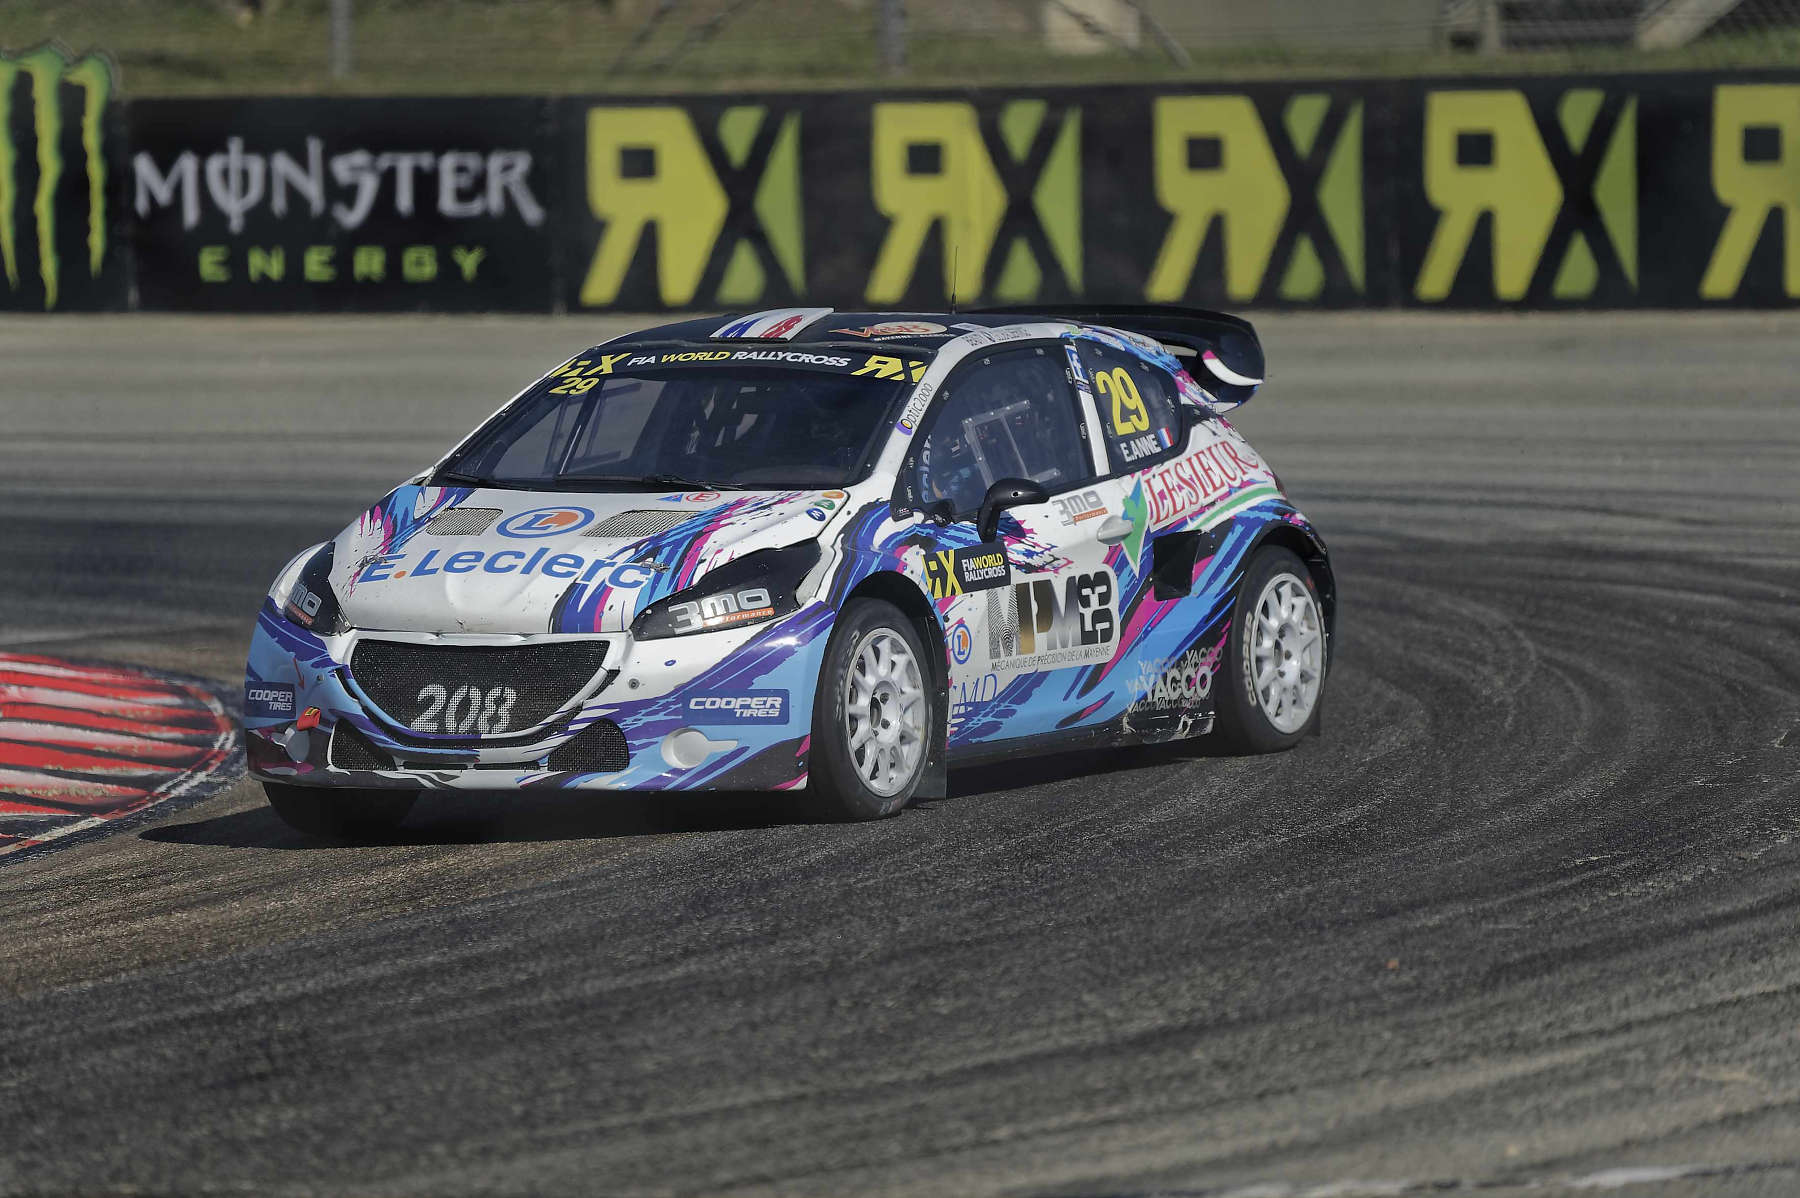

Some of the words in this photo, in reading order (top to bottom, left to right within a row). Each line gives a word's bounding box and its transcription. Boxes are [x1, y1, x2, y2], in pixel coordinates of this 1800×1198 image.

[134, 136, 545, 231] MONSTER
[200, 244, 486, 283] ENERGY
[627, 355, 656, 366] FIA
[661, 351, 731, 364] WORLD
[731, 350, 851, 367] RALLYCROSS
[549, 377, 599, 395] 29
[1096, 367, 1150, 436] 29
[900, 382, 933, 430] Optic2000
[1120, 434, 1162, 462] E.ANNE
[1143, 440, 1259, 526] LESIEUR
[357, 547, 652, 589] E.Leclerc
[964, 565, 1006, 582] RALLYCROSS
[248, 689, 293, 702] COOPER
[1141, 666, 1212, 702] YACCO
[268, 701, 292, 711] TIRES
[410, 683, 517, 735] 208
[689, 697, 782, 709] COOPER
[734, 708, 780, 717] TIRES
